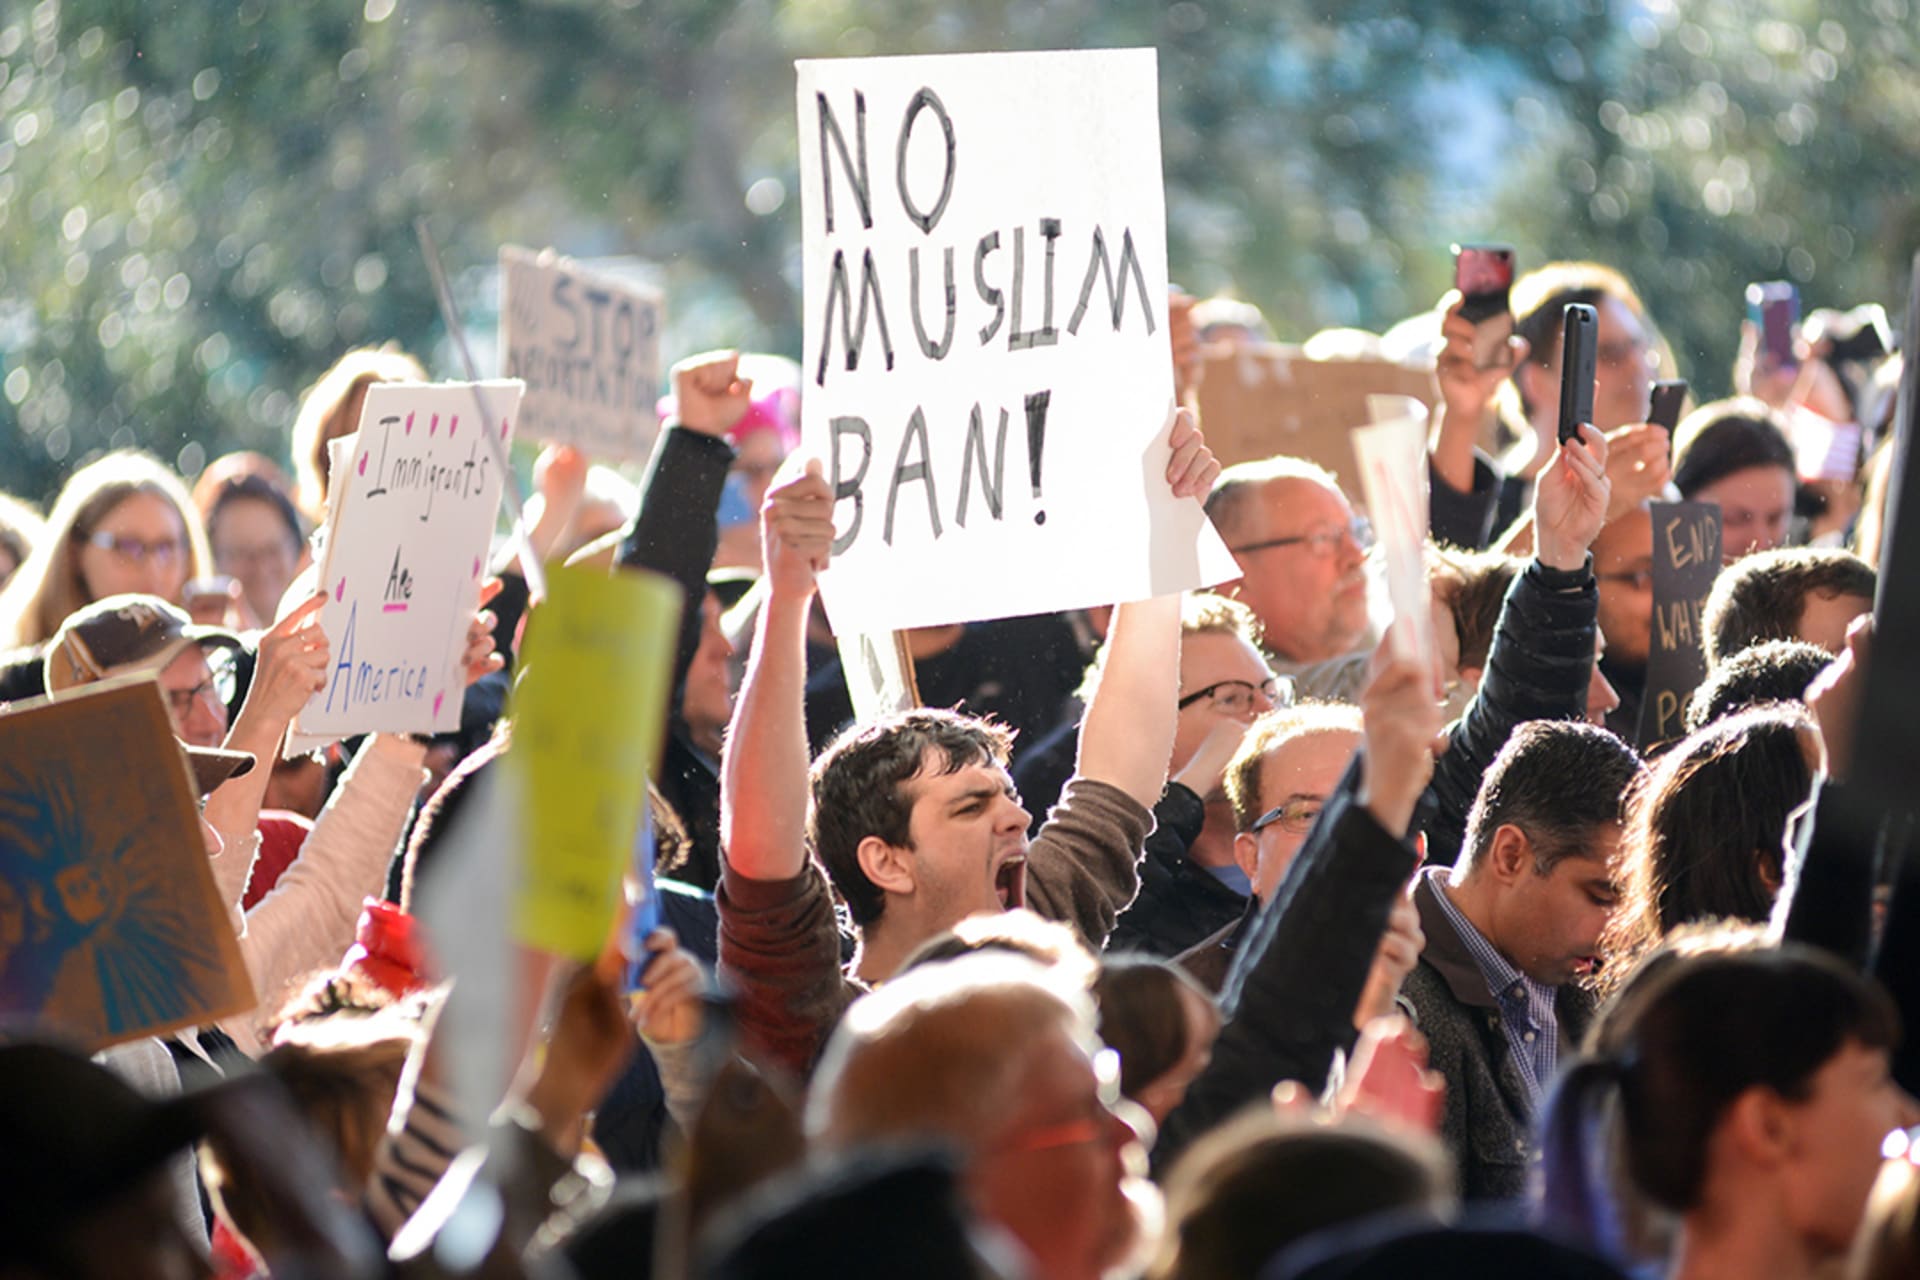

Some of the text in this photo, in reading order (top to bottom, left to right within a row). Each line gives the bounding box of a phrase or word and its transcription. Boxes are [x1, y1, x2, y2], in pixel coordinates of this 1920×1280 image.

[816, 85, 956, 235] NO
[553, 272, 655, 362] STOP
[816, 217, 1156, 387] MUSLIM
[366, 414, 489, 522] Immigrants
[826, 389, 1052, 557] BAN!
[383, 543, 413, 601] Are
[1665, 514, 1718, 569] END
